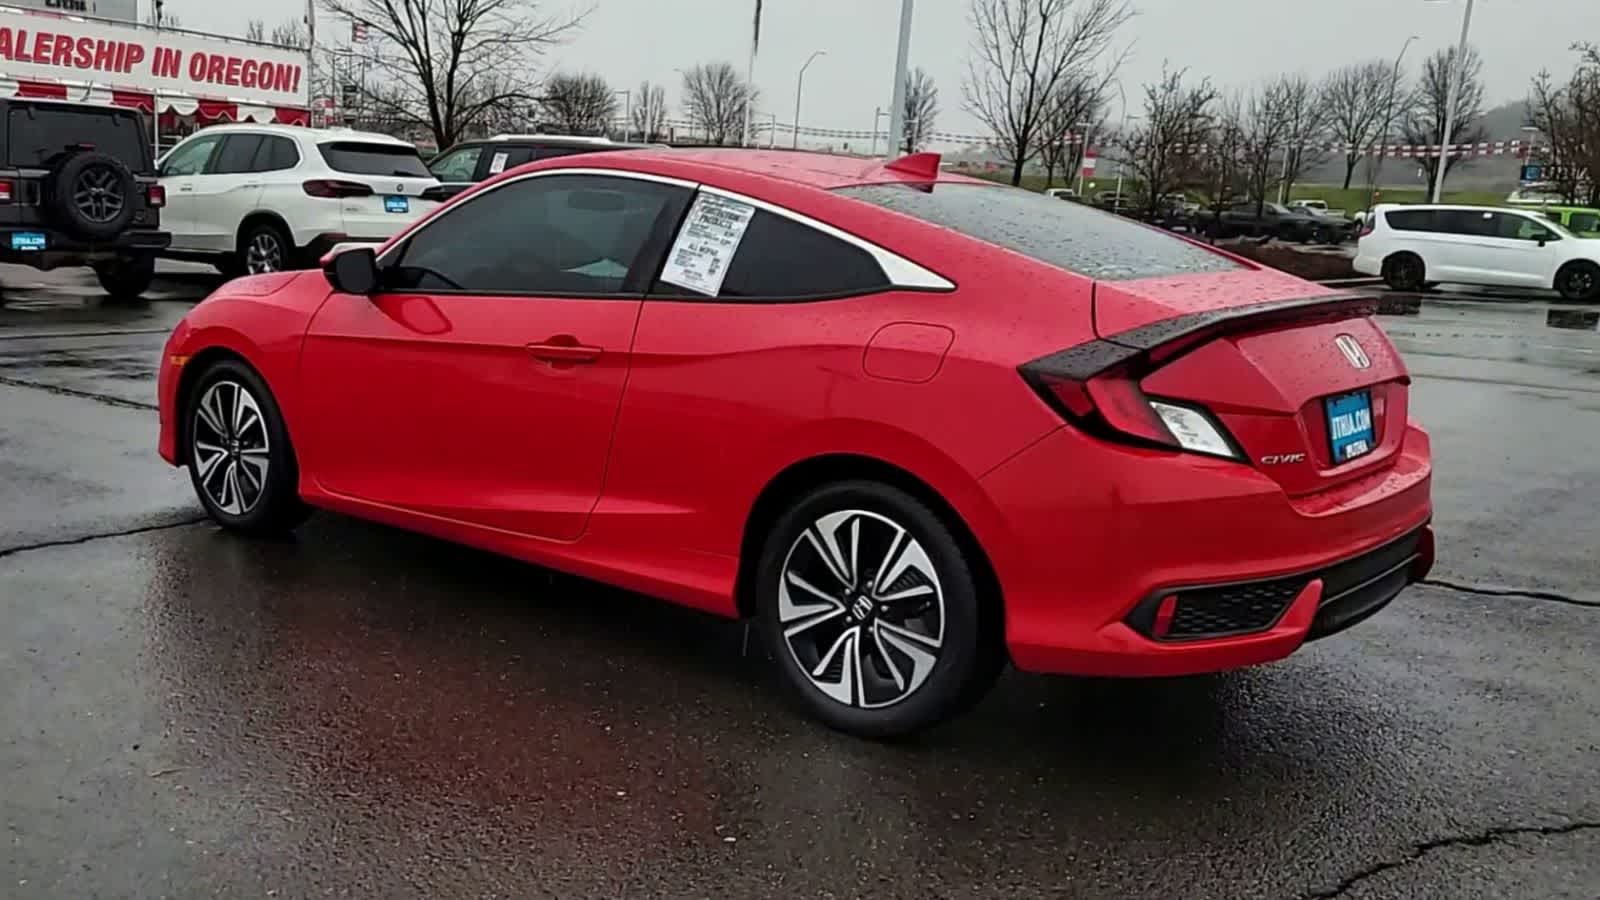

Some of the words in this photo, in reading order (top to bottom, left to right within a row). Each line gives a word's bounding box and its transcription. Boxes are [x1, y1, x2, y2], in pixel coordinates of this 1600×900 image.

[152, 46, 182, 79] IN
[189, 52, 301, 93] OREGON!
[1261, 452, 1306, 464] CIVIC
